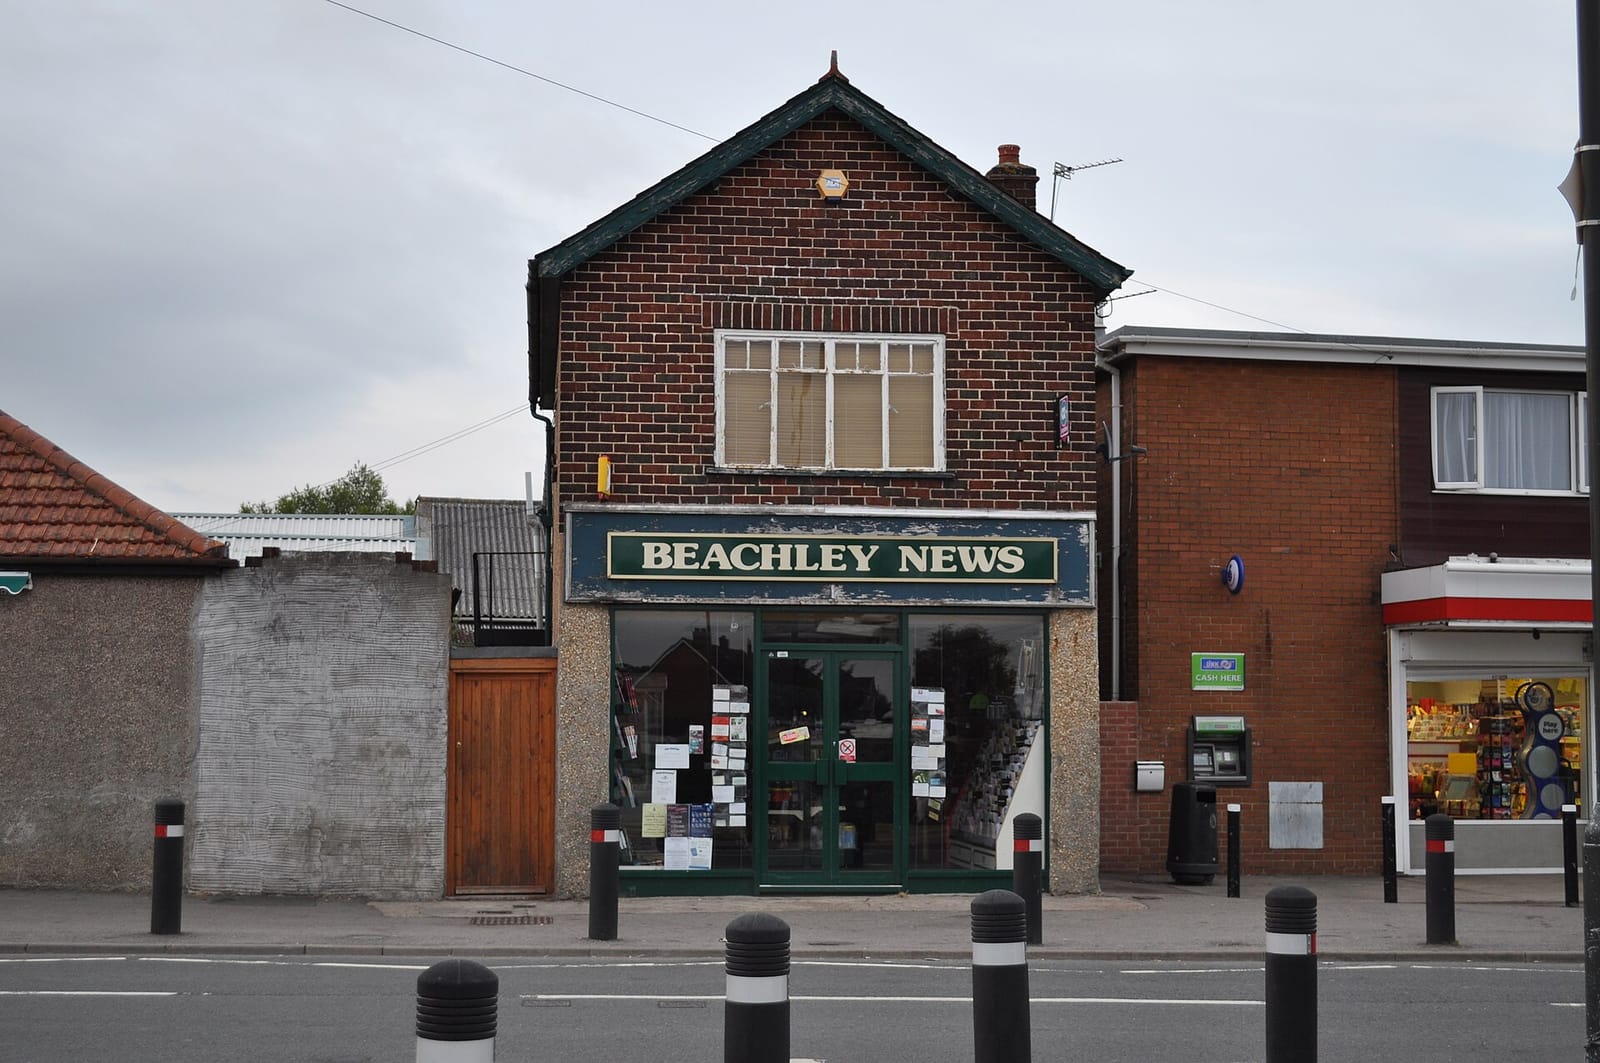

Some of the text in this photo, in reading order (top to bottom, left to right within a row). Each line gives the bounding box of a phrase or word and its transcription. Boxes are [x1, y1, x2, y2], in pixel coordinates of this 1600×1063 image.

[641, 541, 1025, 574] BEACHLEY NEWS
[1195, 673, 1242, 682] CASH HERE
